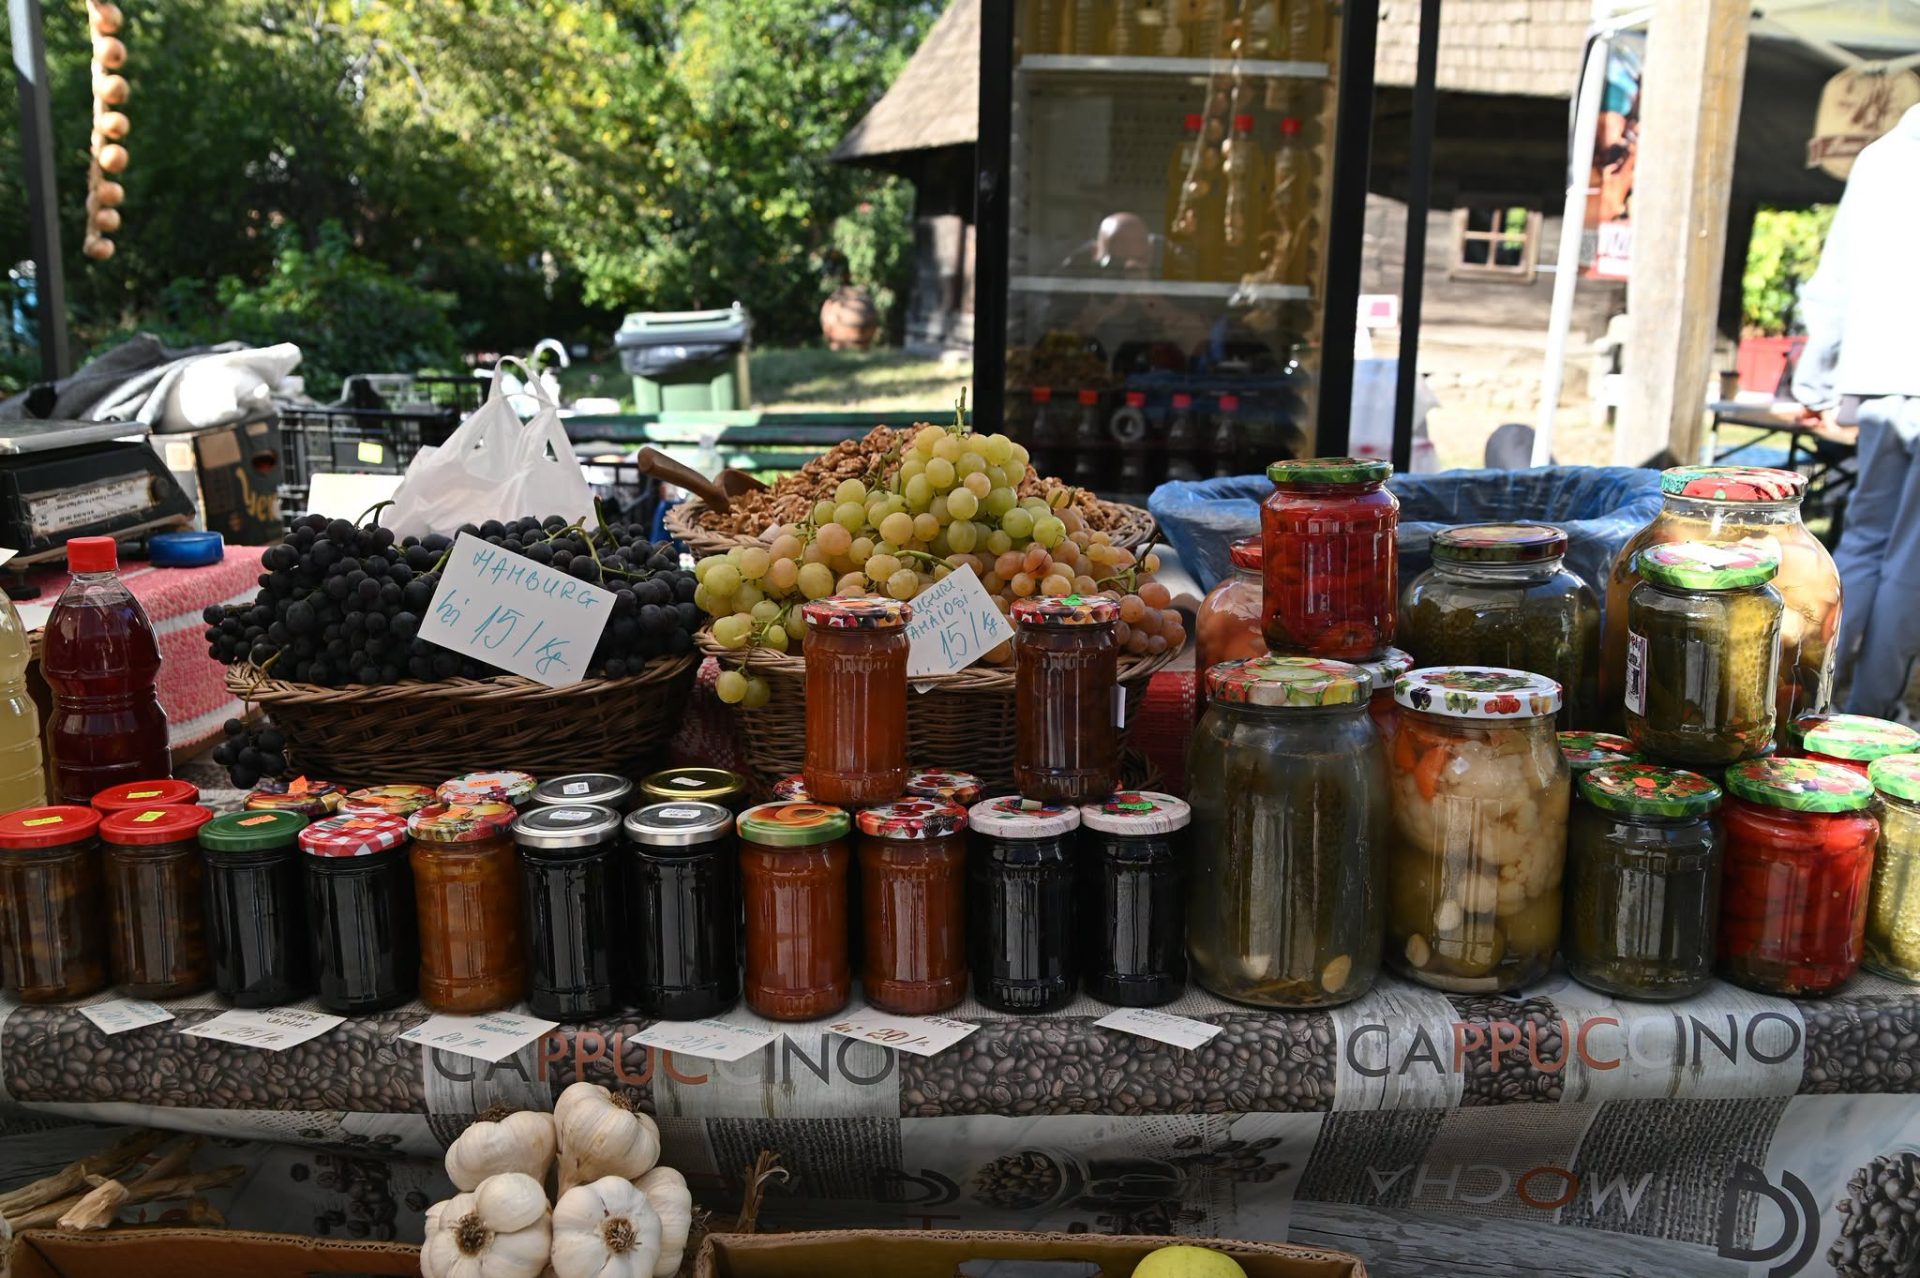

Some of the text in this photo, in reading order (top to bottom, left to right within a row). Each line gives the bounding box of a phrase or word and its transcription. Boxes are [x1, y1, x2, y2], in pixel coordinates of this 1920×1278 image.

[473, 549, 599, 608] HAMBURG
[1346, 1012, 1801, 1077] CAPPUCCINO
[1366, 1164, 1653, 1221] MOCHA
